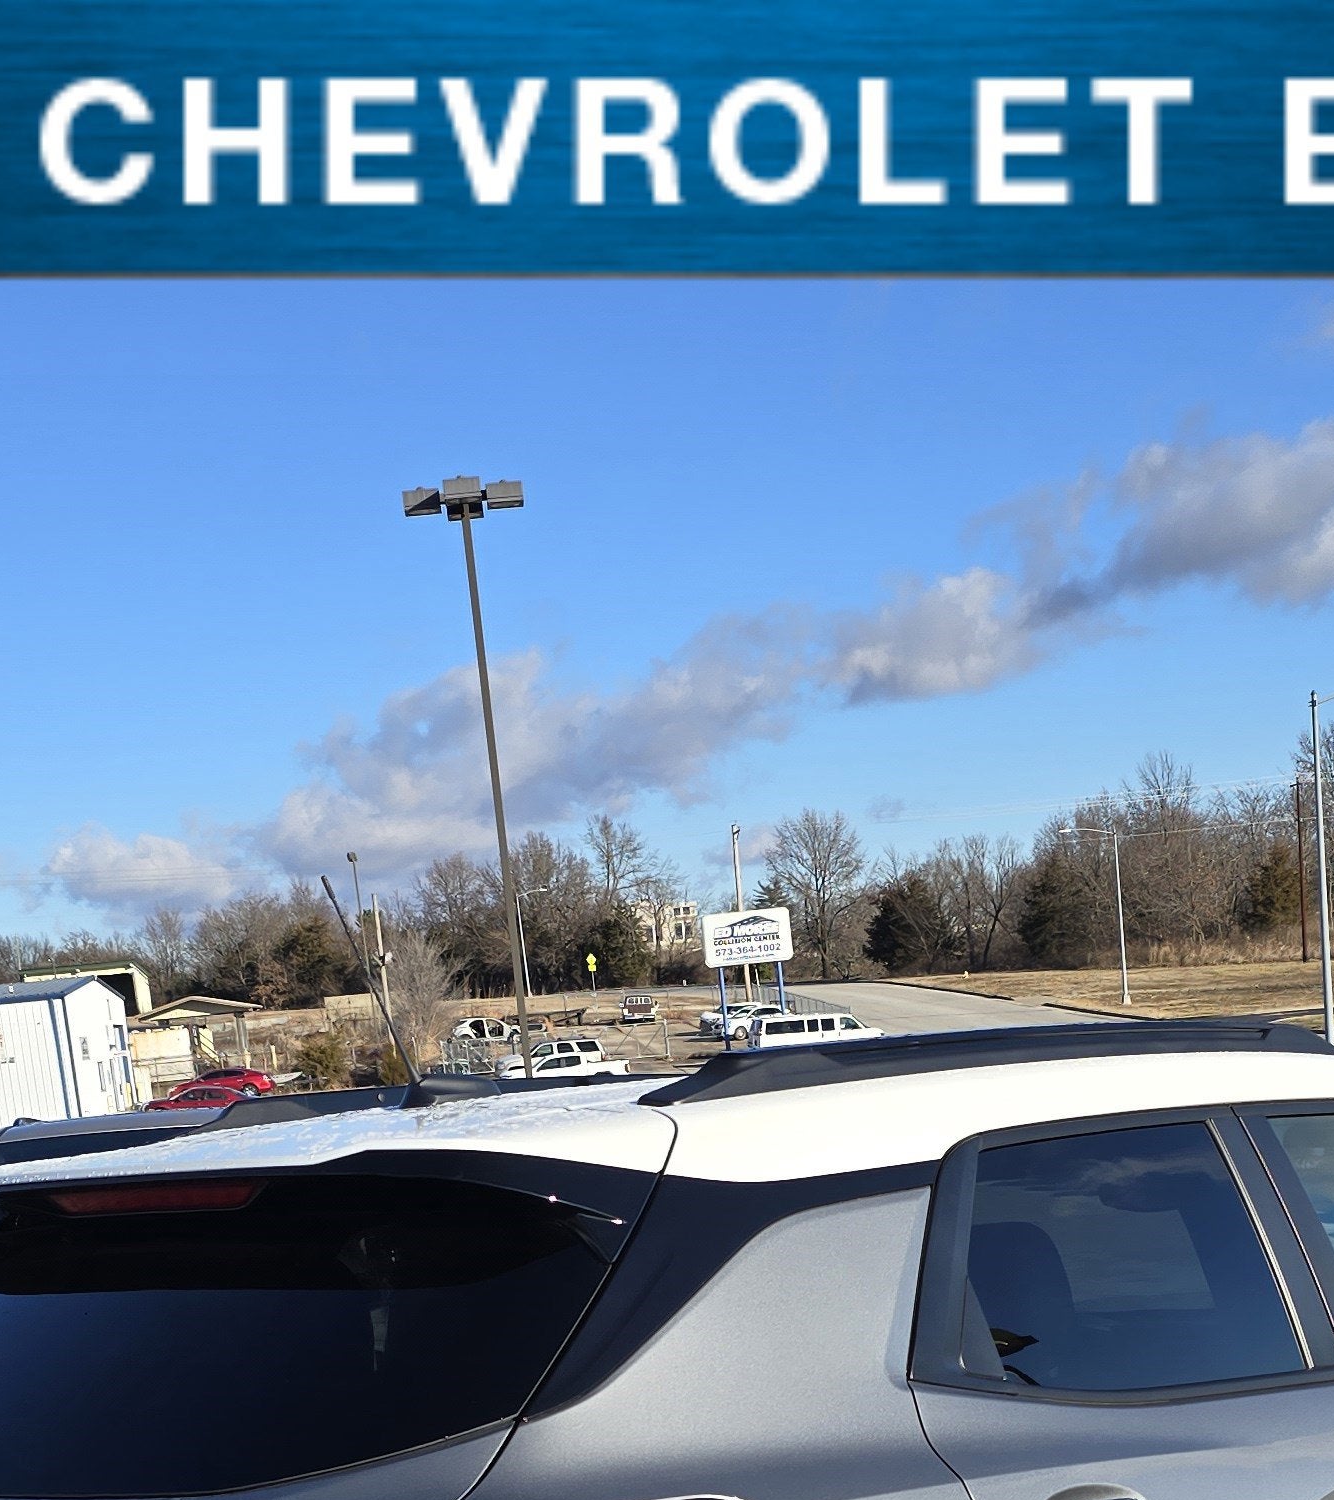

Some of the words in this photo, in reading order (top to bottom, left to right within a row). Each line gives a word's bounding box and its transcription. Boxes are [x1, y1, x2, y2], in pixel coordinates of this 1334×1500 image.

[714, 926, 732, 939] ED
[732, 921, 779, 937] MORSE
[753, 934, 780, 942] CENTER
[715, 943, 781, 957] 573-364-1002
